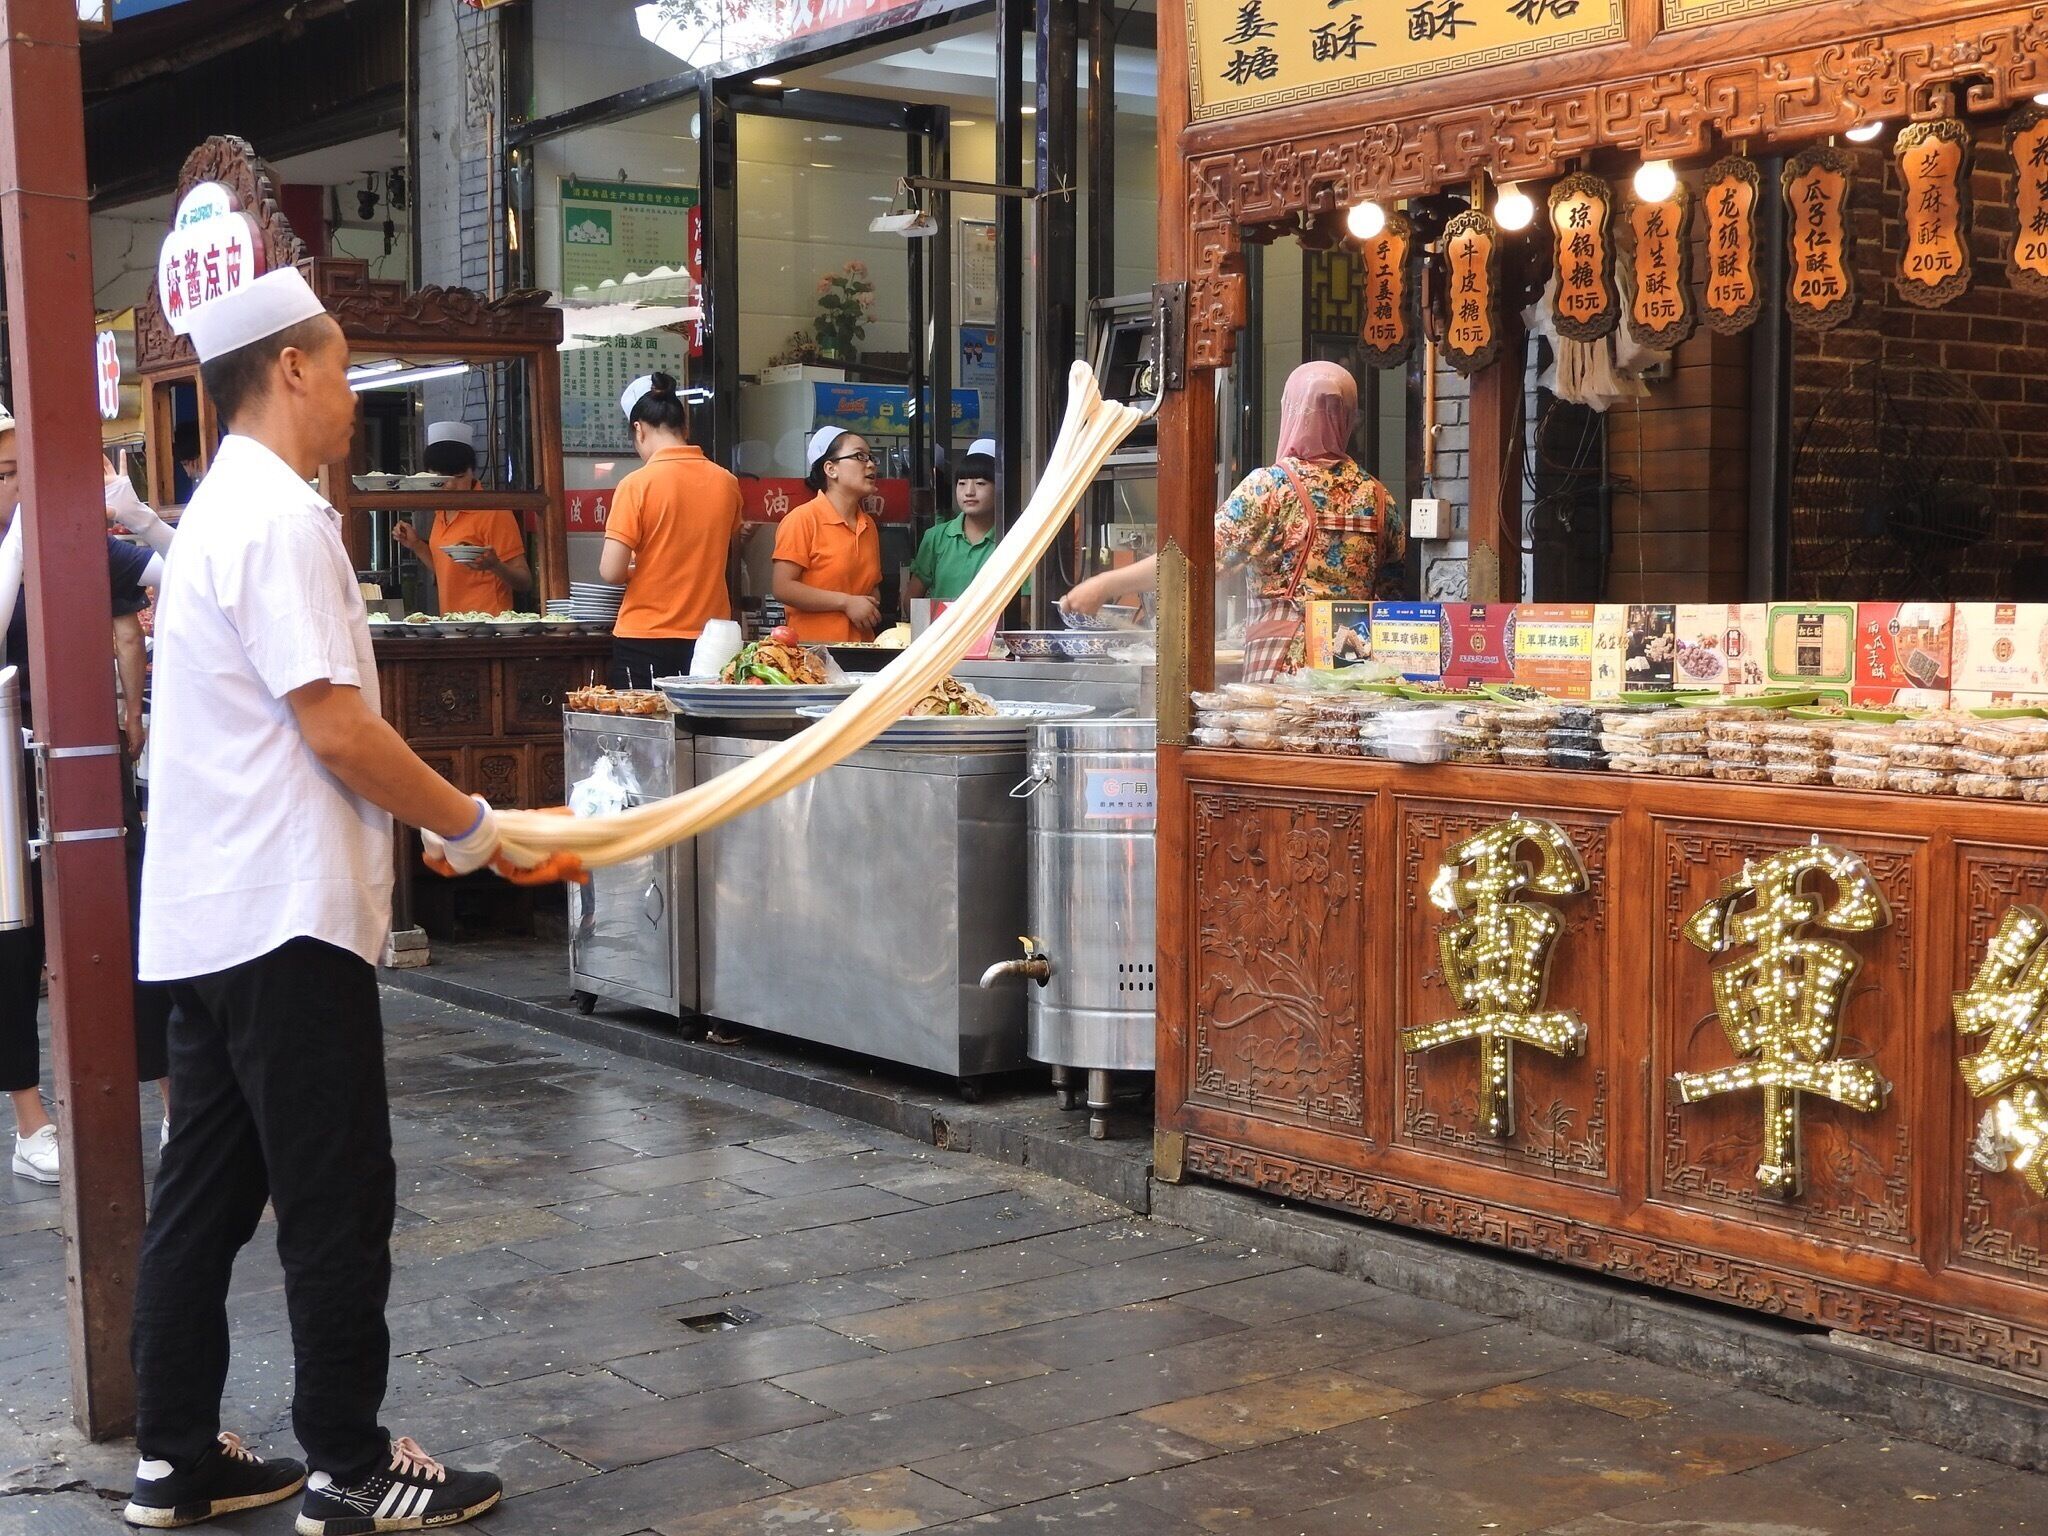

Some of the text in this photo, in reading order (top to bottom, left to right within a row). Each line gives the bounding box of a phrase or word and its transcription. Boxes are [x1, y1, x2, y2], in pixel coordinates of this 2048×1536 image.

[1917, 150, 1947, 246] 芝麻酥
[1718, 187, 1742, 278] 龙须酥
[1802, 179, 1832, 272] 瓜子仁酥
[1568, 203, 1595, 289] 琼锅糖
[1644, 207, 1671, 295] 花生酥
[1912, 251, 1953, 272] 20元
[1374, 241, 1394, 320] 手工姜糖
[1459, 239, 1482, 323] 牛皮糖
[1800, 276, 1839, 298] 20元
[1567, 292, 1600, 311] 15元
[1714, 283, 1746, 302] 15元
[1642, 300, 1676, 318] 15元
[1369, 325, 1397, 340] 15元
[1455, 326, 1484, 342] 15元
[425, 1513, 458, 1524] adidas
